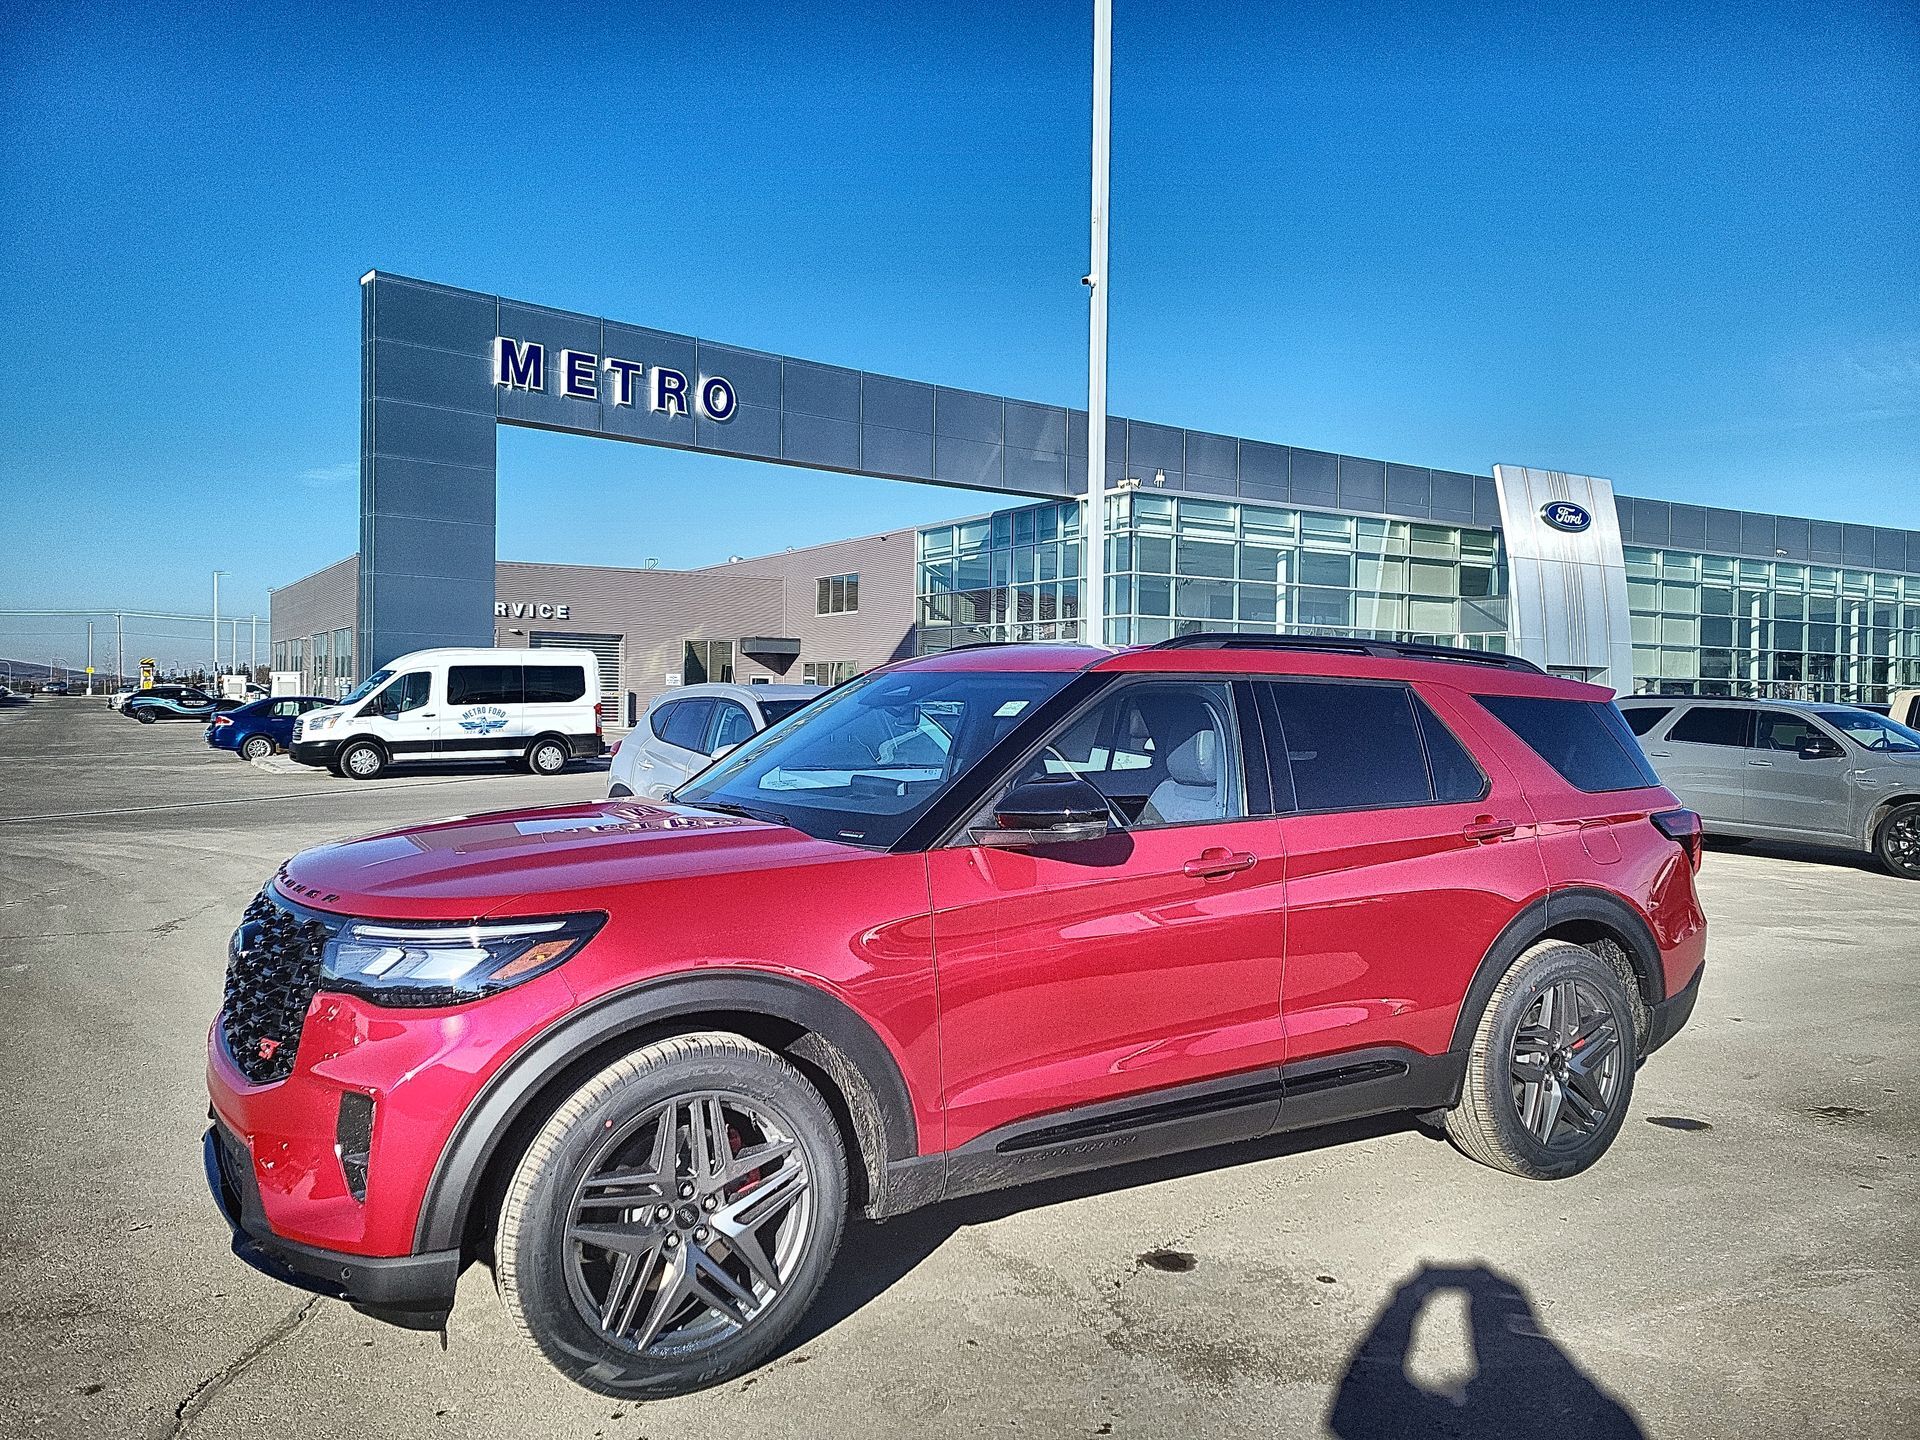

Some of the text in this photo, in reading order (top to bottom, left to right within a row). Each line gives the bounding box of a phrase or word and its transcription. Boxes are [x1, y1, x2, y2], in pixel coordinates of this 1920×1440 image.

[494, 336, 737, 421] METRO
[1556, 506, 1583, 525] Ford
[494, 601, 569, 619] RVICE
[462, 706, 506, 720] METRO FORD
